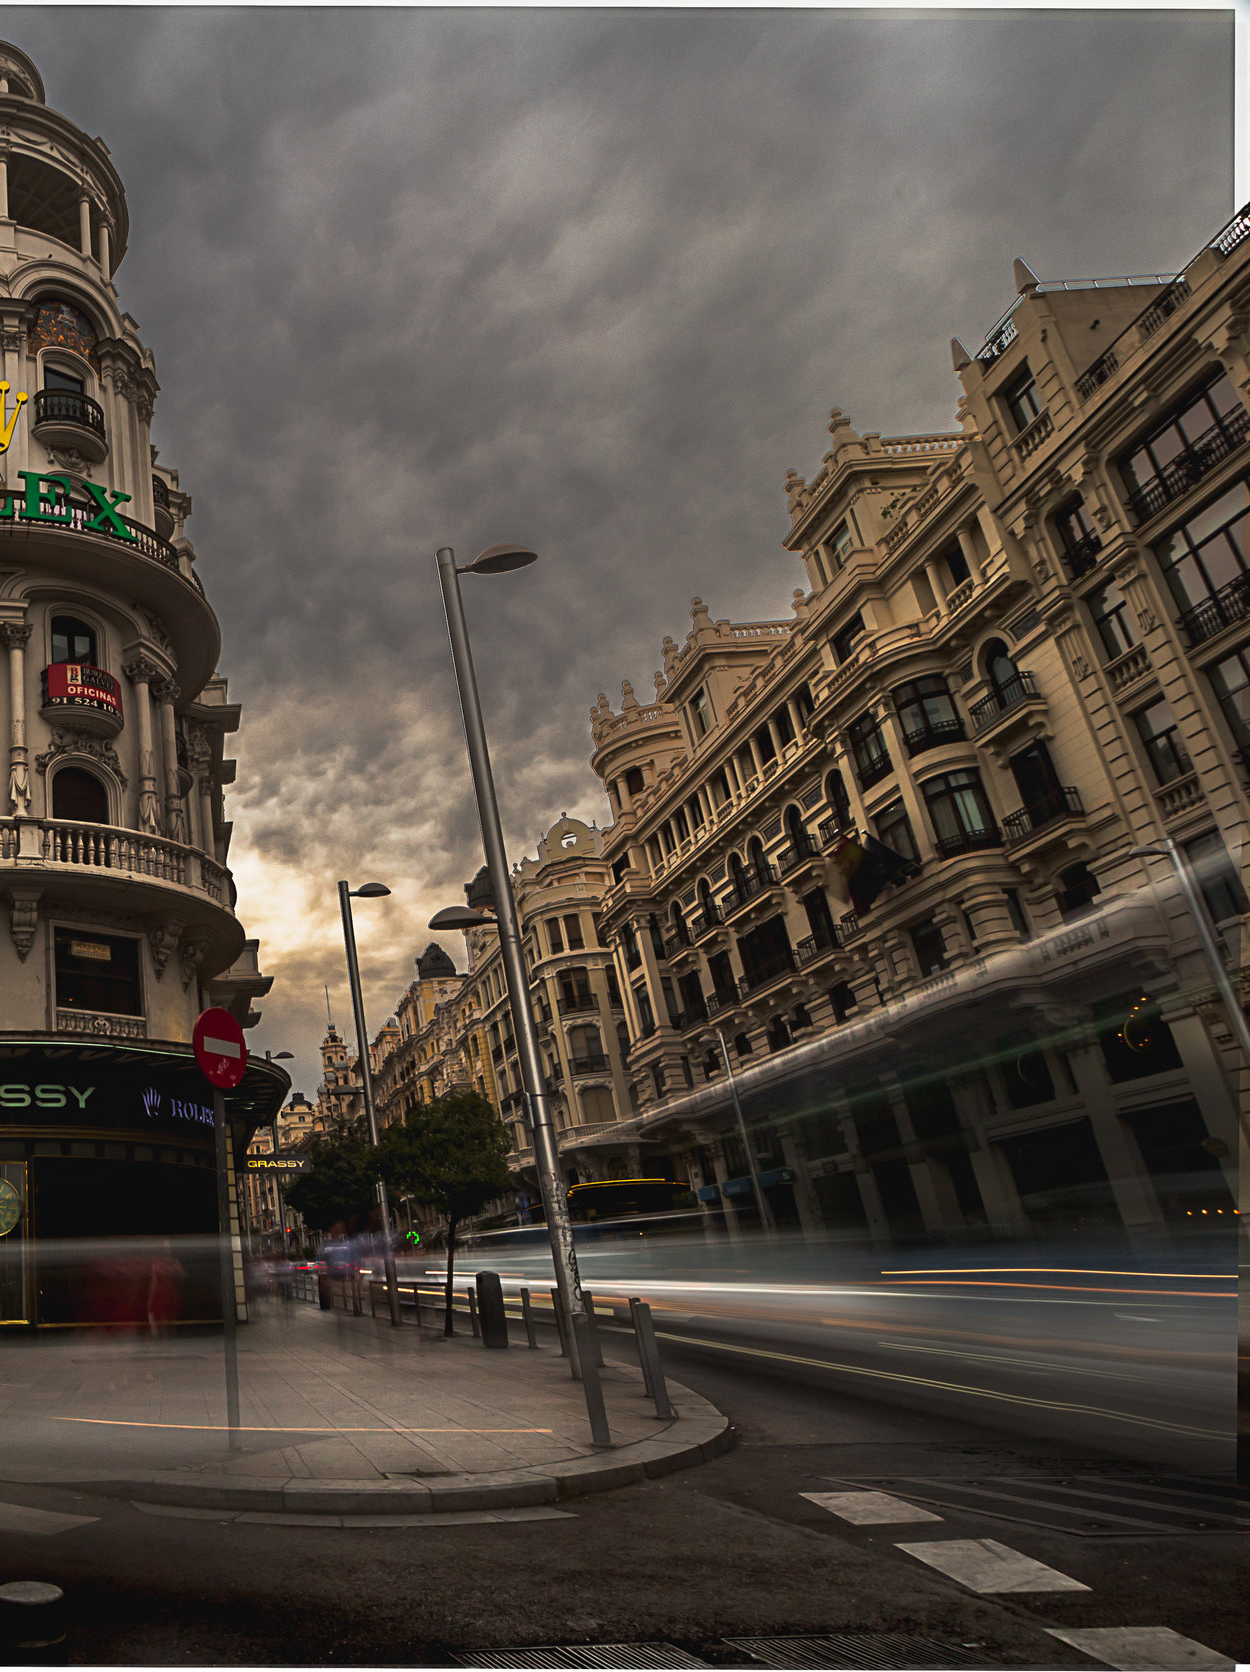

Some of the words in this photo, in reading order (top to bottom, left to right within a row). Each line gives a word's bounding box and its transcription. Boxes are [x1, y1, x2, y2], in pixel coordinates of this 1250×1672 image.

[67, 686, 117, 706] OFICINAS
[52, 697, 68, 705] 91
[74, 697, 98, 708] 524
[103, 703, 114, 713] 10
[247, 1160, 305, 1168] GRASSY
